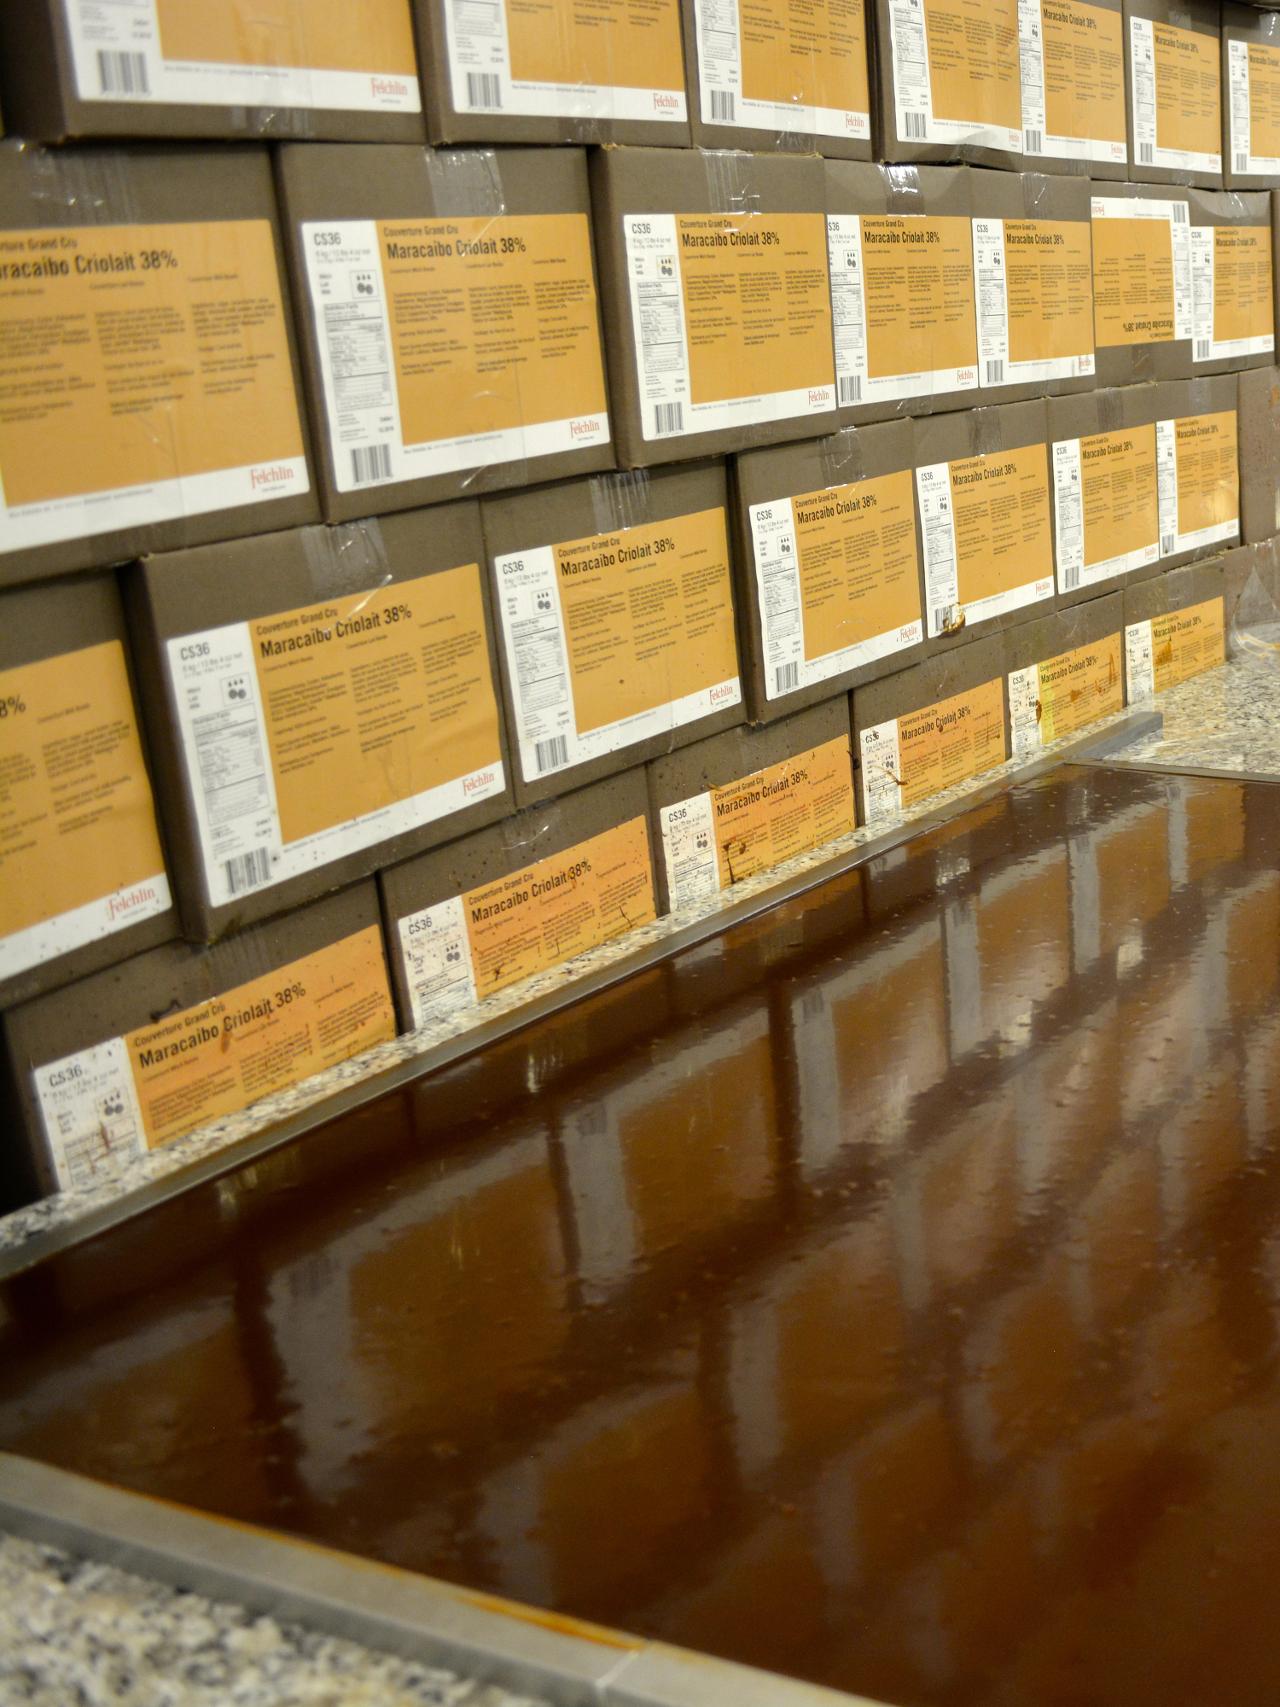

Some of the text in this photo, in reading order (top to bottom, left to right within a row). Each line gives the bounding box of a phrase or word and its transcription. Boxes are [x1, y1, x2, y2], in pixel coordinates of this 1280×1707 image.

[371, 77, 408, 97] Felchlin
[653, 93, 679, 109] Felchlin
[845, 113, 864, 128] Felchlin
[383, 224, 459, 238] Couverture Grand Cru
[632, 223, 651, 234] CS36
[680, 220, 732, 229] Couverture Grand Cru
[828, 221, 840, 232] S36
[863, 220, 885, 228] Couverture
[886, 219, 896, 228] Grand
[27, 237, 56, 249] Grand
[60, 237, 77, 248] Cru
[313, 232, 342, 246] CS36
[682, 231, 780, 248] Maracaibo Criolait 38%
[864, 231, 940, 244] Maracaibo Criolait 38%
[1006, 233, 1064, 245] Maracaibo Criolait 38%
[386, 240, 453, 260] Maracaibo
[456, 238, 498, 256] Criolait
[500, 237, 526, 253] 38%
[0, 249, 178, 279] racaibo Criolait 38%
[957, 369, 974, 384] Felchlin
[808, 390, 830, 405] Felchlin
[570, 420, 600, 438] Felchlin
[1082, 440, 1133, 459] Maracaibo Criolait 38%
[251, 466, 295, 489] Felchlin
[921, 472, 933, 482] CS36
[952, 463, 1017, 486] Maracaibo Criolait 38%
[795, 492, 838, 508] Couverture Grand Cru
[797, 494, 877, 524] Maracaibo Criolait 38%
[756, 509, 772, 521] CS36
[558, 537, 620, 558] Couverture Grand Cru
[561, 537, 675, 576] Maracaibo Criolait 38%
[502, 561, 524, 575] CS36
[257, 608, 338, 636] Couverture Grand Cru
[259, 603, 412, 658] Maracaibo Criolait 38%
[180, 641, 210, 661] CS36
[1041, 655, 1097, 684] Maracaibo Criolait 38%
[709, 686, 733, 705] Felchlin
[0, 695, 26, 718] 8%
[901, 705, 971, 740] Maracaibo Criolait 38%
[463, 773, 494, 796] Felchlin
[714, 778, 764, 800] Couverture Grand Cru
[717, 769, 808, 817] Maracaibo Criolait 38%
[668, 808, 687, 822] CS36
[469, 873, 534, 906] Couverture Grand Cru
[471, 860, 592, 923] Maracaibo Criolait 38%
[108, 887, 156, 921] Felchlin
[408, 917, 432, 935] CS36
[135, 1002, 226, 1048] Couverture Grand Cru
[139, 981, 306, 1068] Maracaibo Criolait 38%
[49, 1064, 83, 1087] CS36
